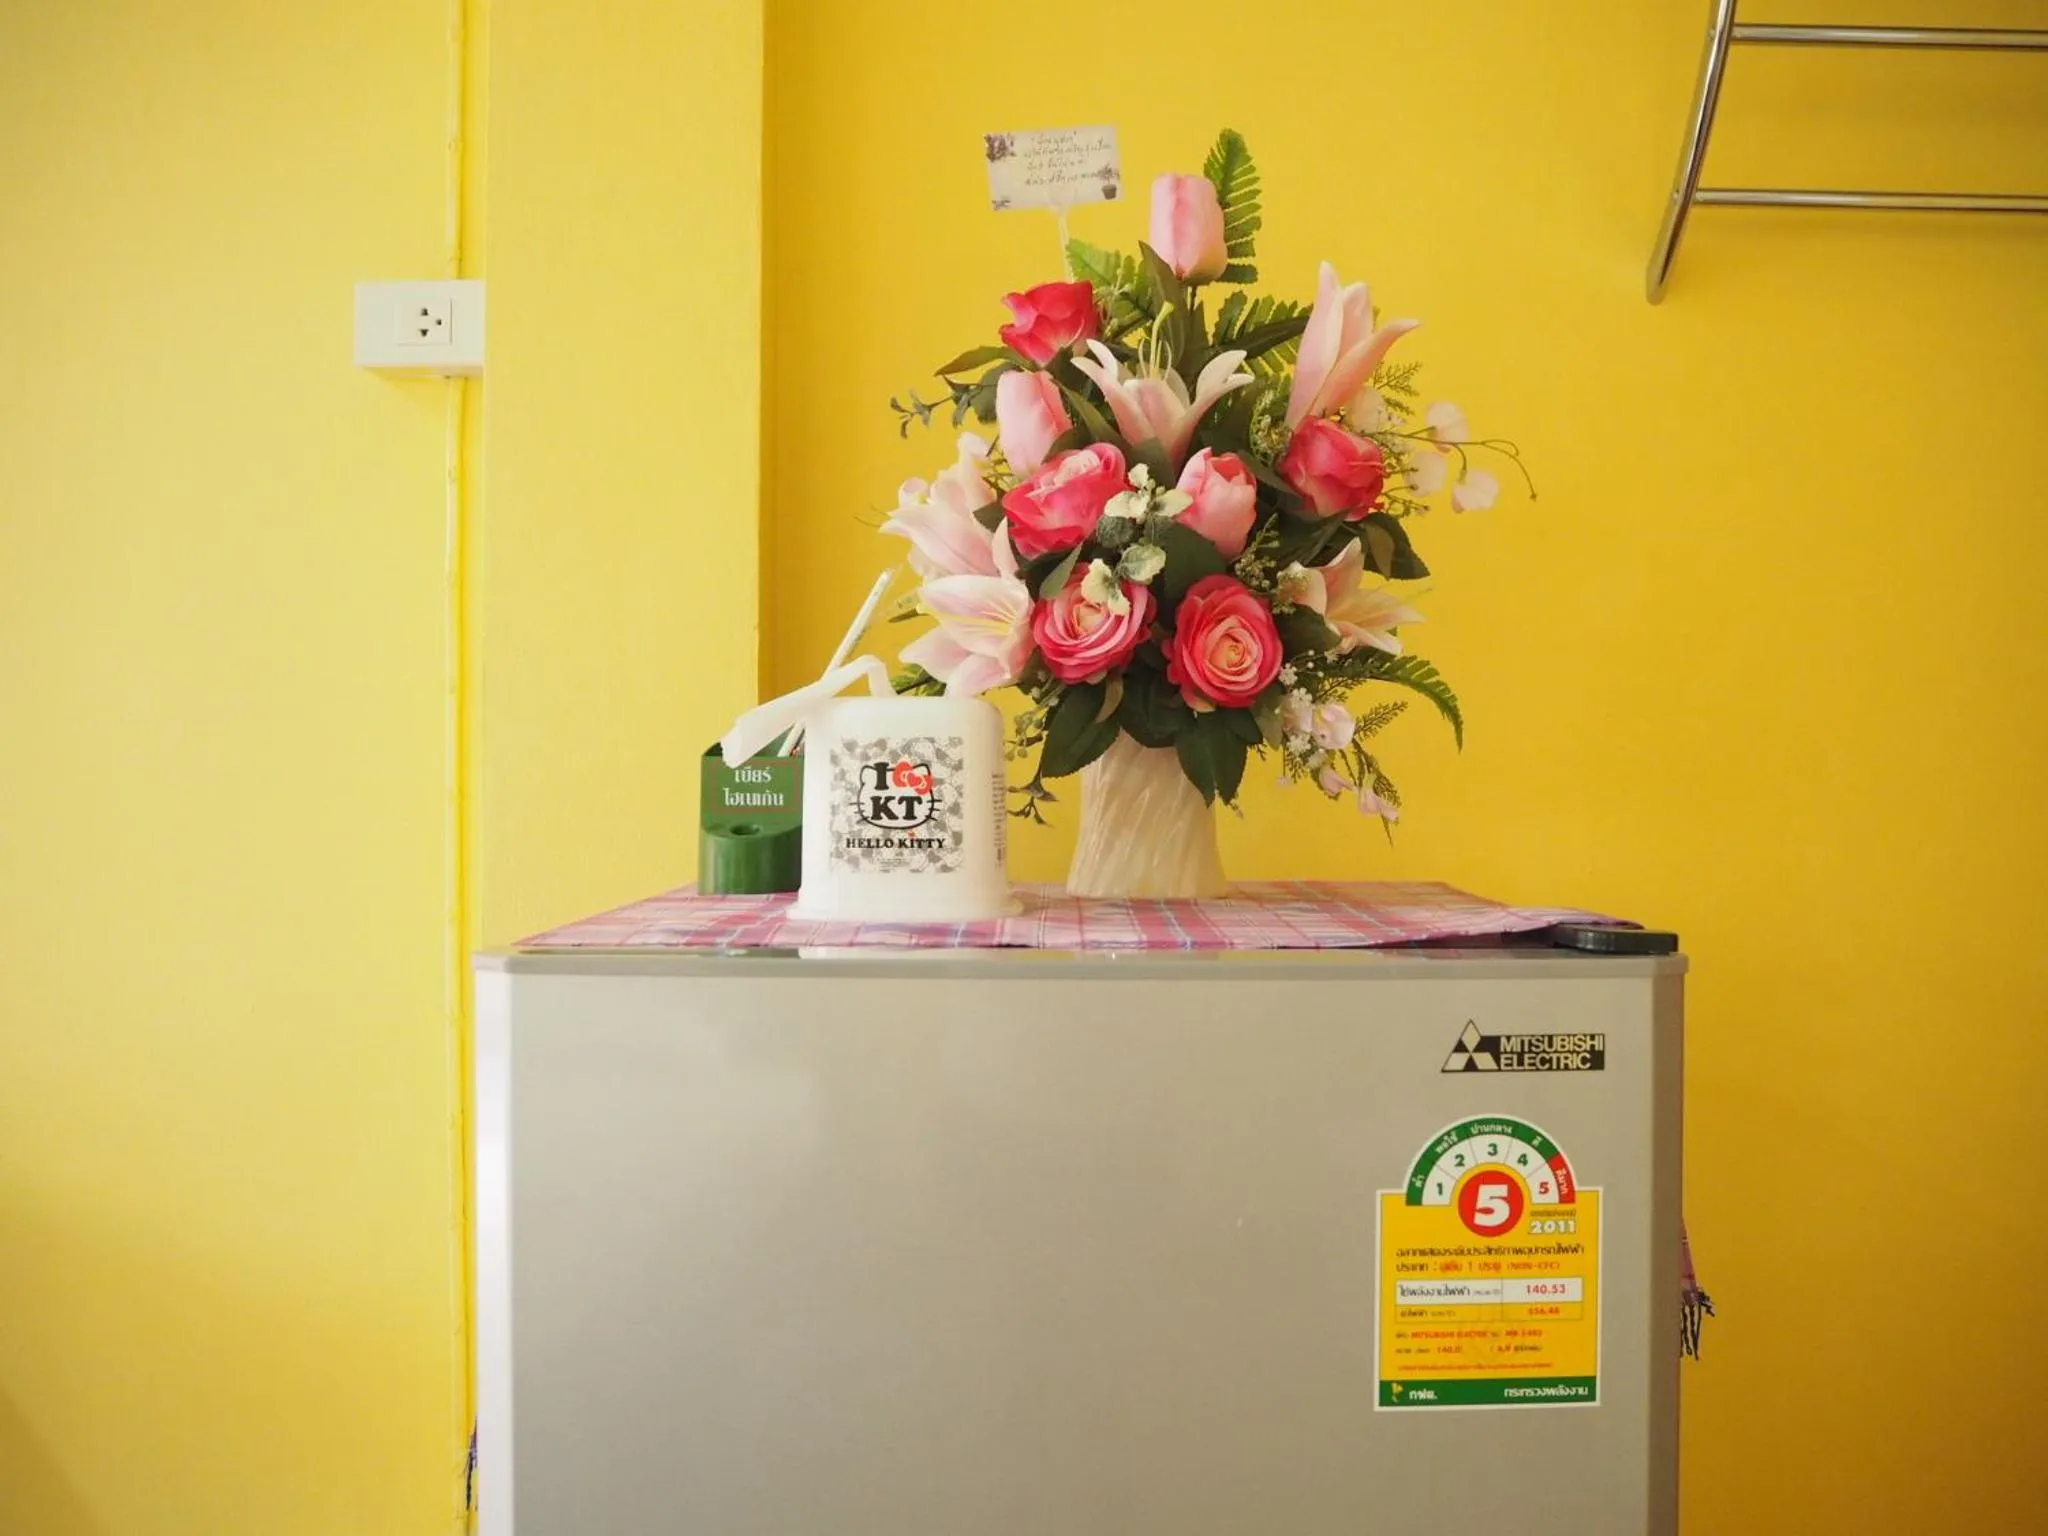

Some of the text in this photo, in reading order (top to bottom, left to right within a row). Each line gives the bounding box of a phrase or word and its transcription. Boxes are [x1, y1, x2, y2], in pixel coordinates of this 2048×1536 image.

[734, 766, 772, 783] เบียร์
[874, 762, 890, 790] I
[870, 796, 923, 820] KT
[846, 838, 945, 849] HELLO KITTY
[1500, 1035, 1604, 1052] MITSUBISHI
[1500, 1053, 1591, 1070] ELECTRIC
[1487, 1143, 1498, 1157] 3
[1454, 1154, 1466, 1168] 2
[1517, 1152, 1529, 1167] 4
[1436, 1182, 1444, 1196] 1
[1539, 1181, 1550, 1195] 5
[1473, 1183, 1511, 1227] 5
[1530, 1220, 1576, 1233] 2011
[1526, 1283, 1567, 1294] 140.53
[1503, 1384, 1589, 1398] กระทรวงพลังงาน
